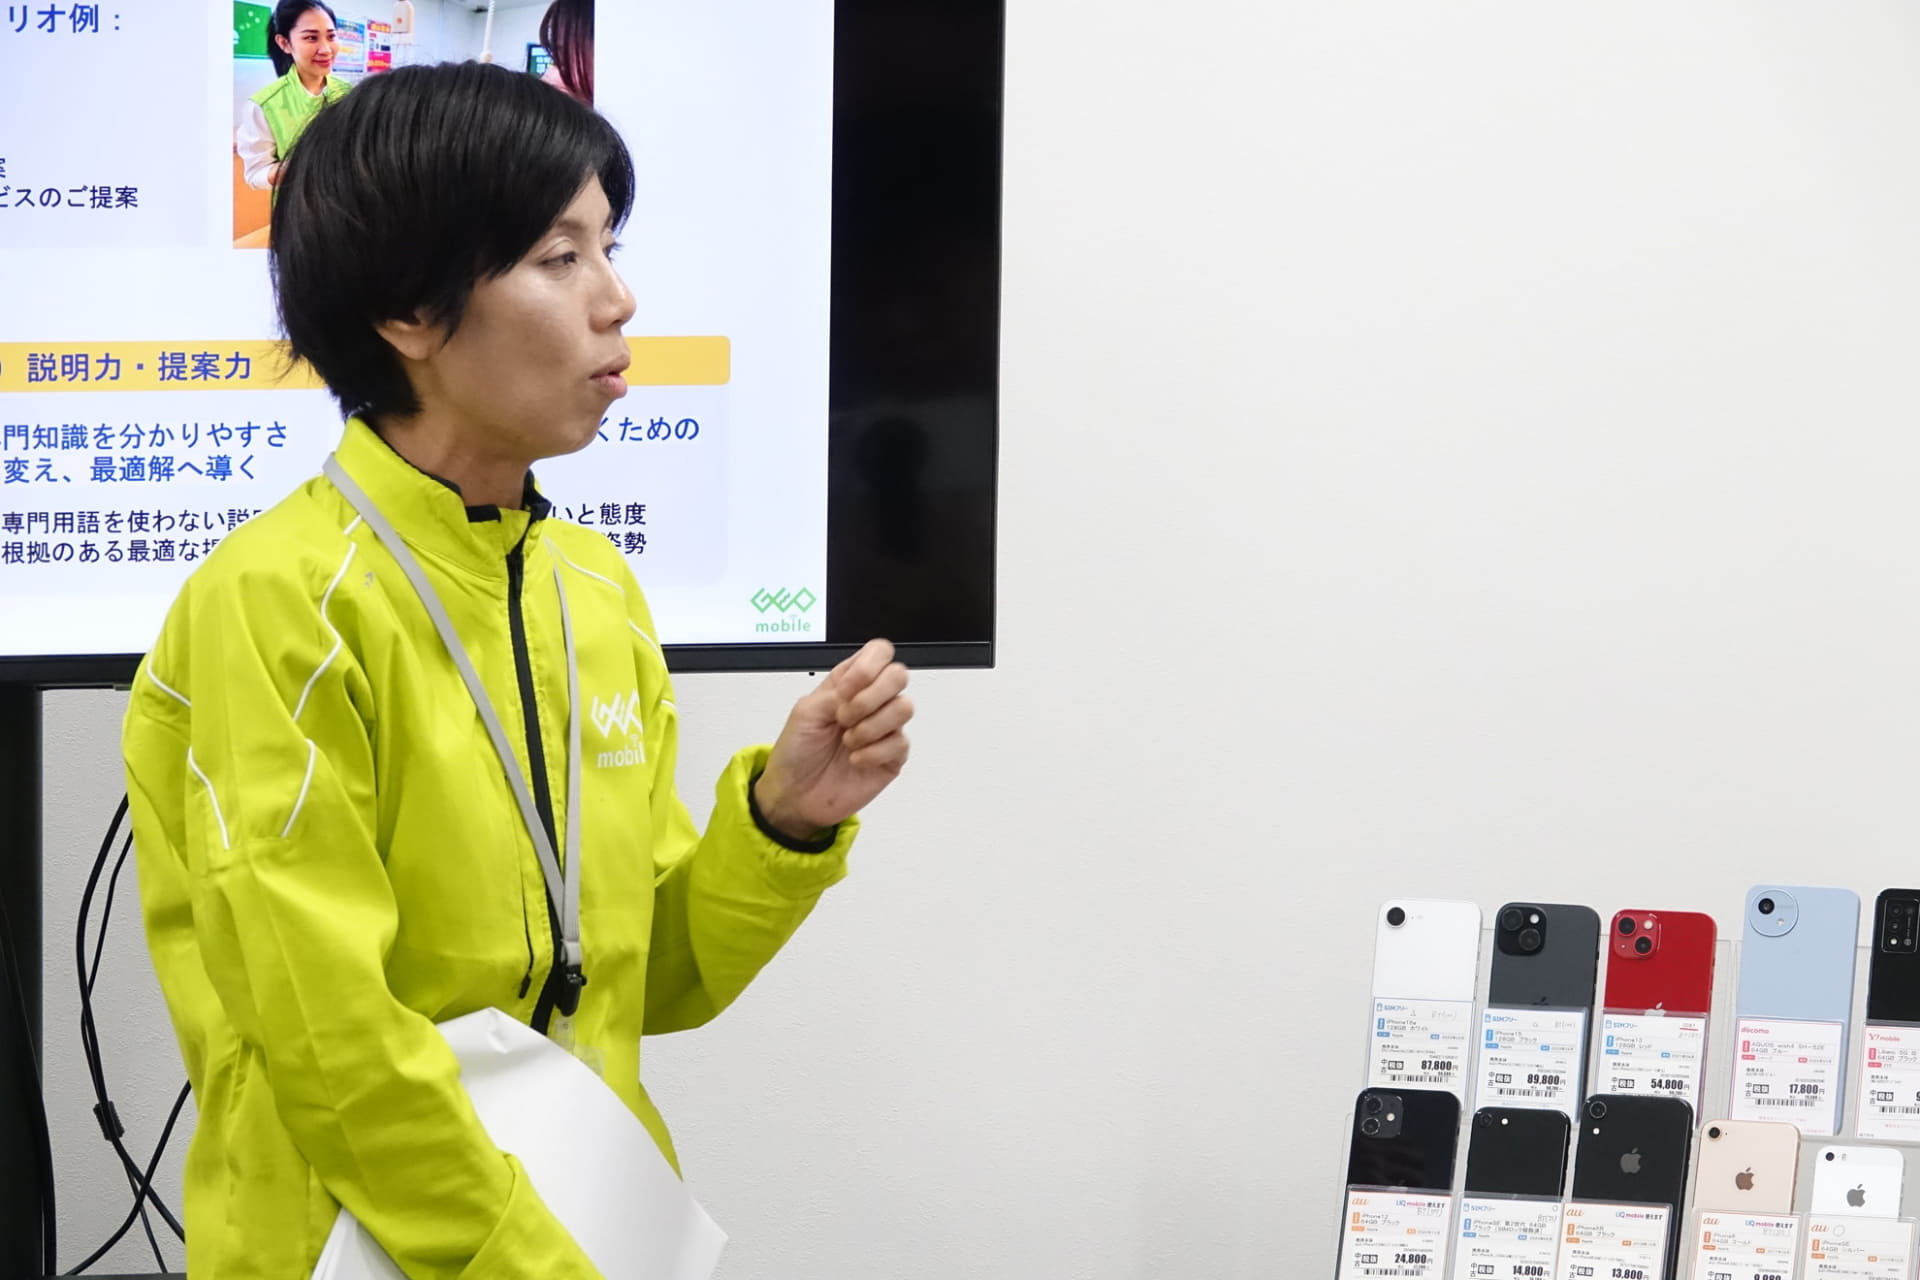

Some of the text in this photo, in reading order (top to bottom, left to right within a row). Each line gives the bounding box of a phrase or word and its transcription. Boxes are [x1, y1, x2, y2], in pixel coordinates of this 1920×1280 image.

[27, 352, 252, 382] 説明力・提案力
[0, 421, 288, 451] 門知識を分かりやすさ
[3, 454, 256, 484] 変え、最適解へ導く
[1, 508, 263, 534] 専門用語を使わない説
[755, 616, 811, 632] mobile
